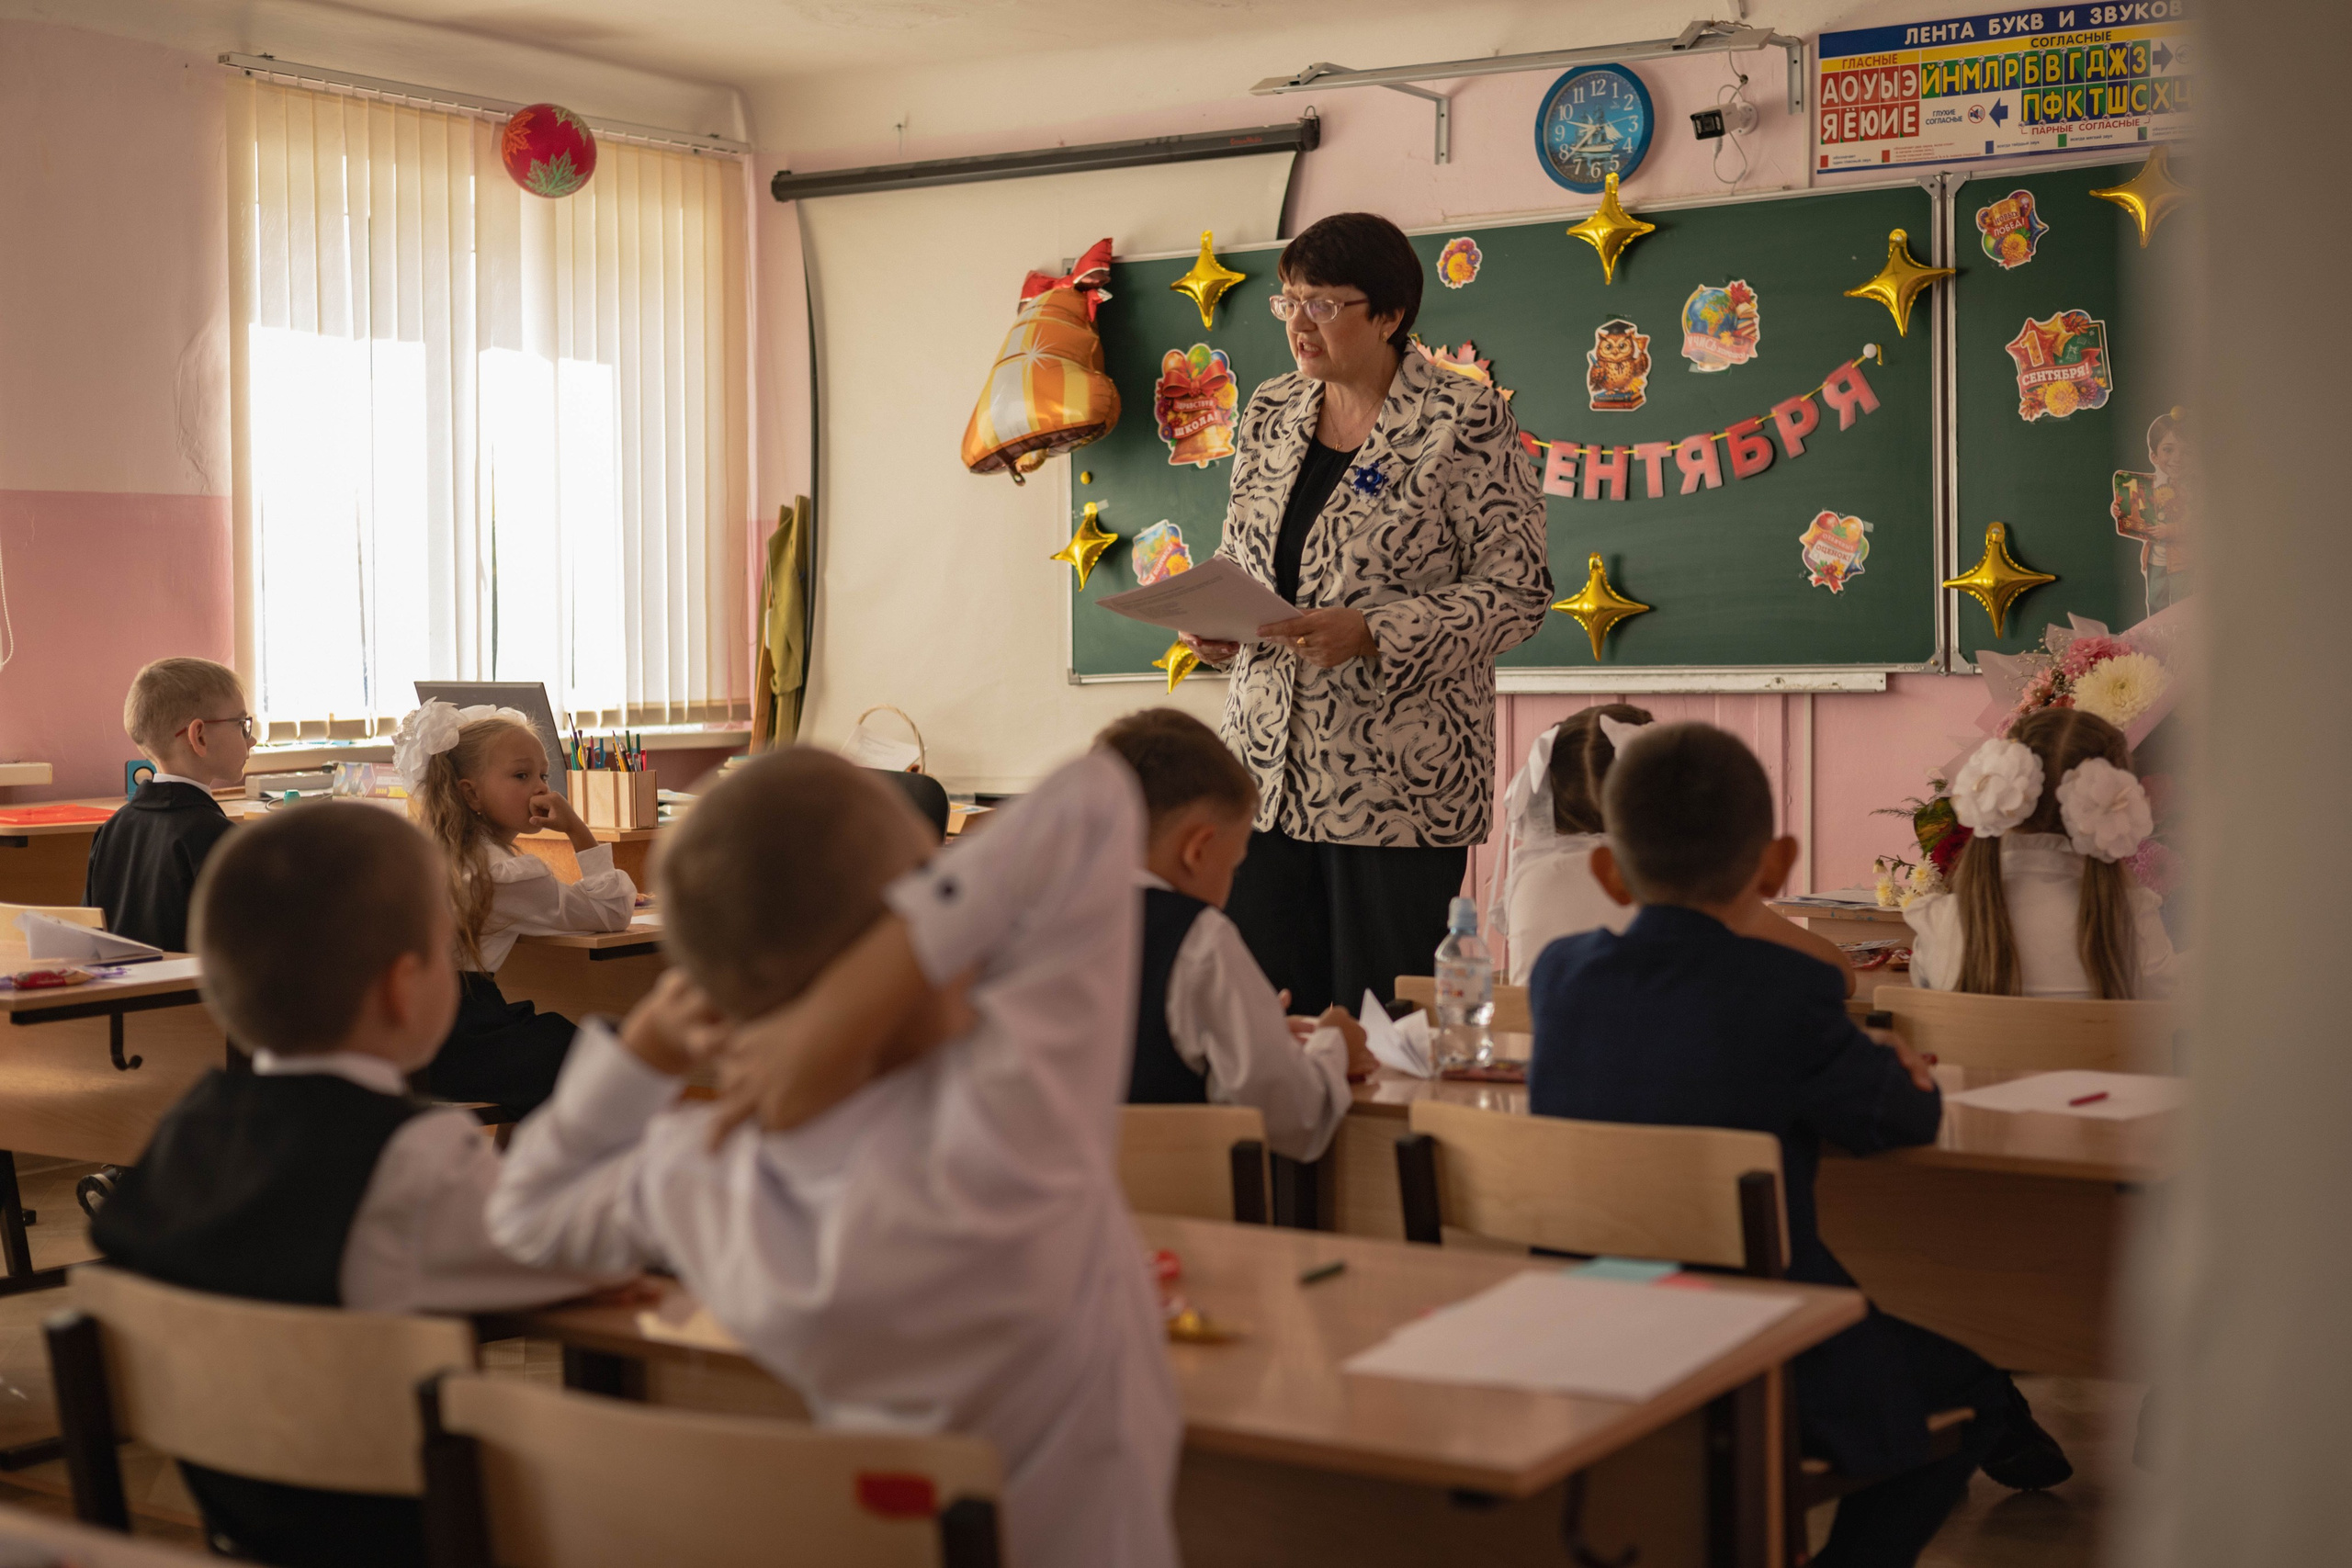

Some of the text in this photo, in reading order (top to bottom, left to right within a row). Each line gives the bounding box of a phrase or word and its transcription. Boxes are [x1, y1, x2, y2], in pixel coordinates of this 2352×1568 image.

[1905, 1, 2183, 45] ЛЕНТА БУКВ И ЗВУКОВ
[2030, 30, 2112, 48] СОГЛАСНЫЕ
[1841, 53, 1898, 70] ГЛАСНЫЕ
[1573, 86, 1585, 104] 11
[1590, 79, 1606, 96] 12
[1612, 82, 1619, 98] 1
[1623, 94, 1634, 111] 2
[1558, 104, 1573, 121] 10
[1925, 116, 1963, 126] СОГЛАСНЫЕ
[1932, 108, 1956, 117] ГЛУХИЕ
[1628, 115, 1638, 132] 3
[2031, 123, 2074, 135] ПАРНЫЕ
[2078, 118, 2141, 132] СОГЛАСНЫЕ
[1555, 125, 1566, 141] 9
[1559, 143, 1569, 161] 8
[1623, 137, 1633, 153] 4
[1573, 158, 1582, 175] 7
[1590, 162, 1601, 178] 6
[1610, 154, 1620, 172] 5
[1995, 211, 2019, 225] НОВЫХ
[1994, 218, 2025, 236] ПОБЕД!
[2019, 330, 2044, 367] 1
[2021, 362, 2090, 386] СЕНТЯБРЯ!
[1174, 411, 1218, 437] ШКОЛА!
[1815, 545, 1851, 562] ОЦЕНОК!
